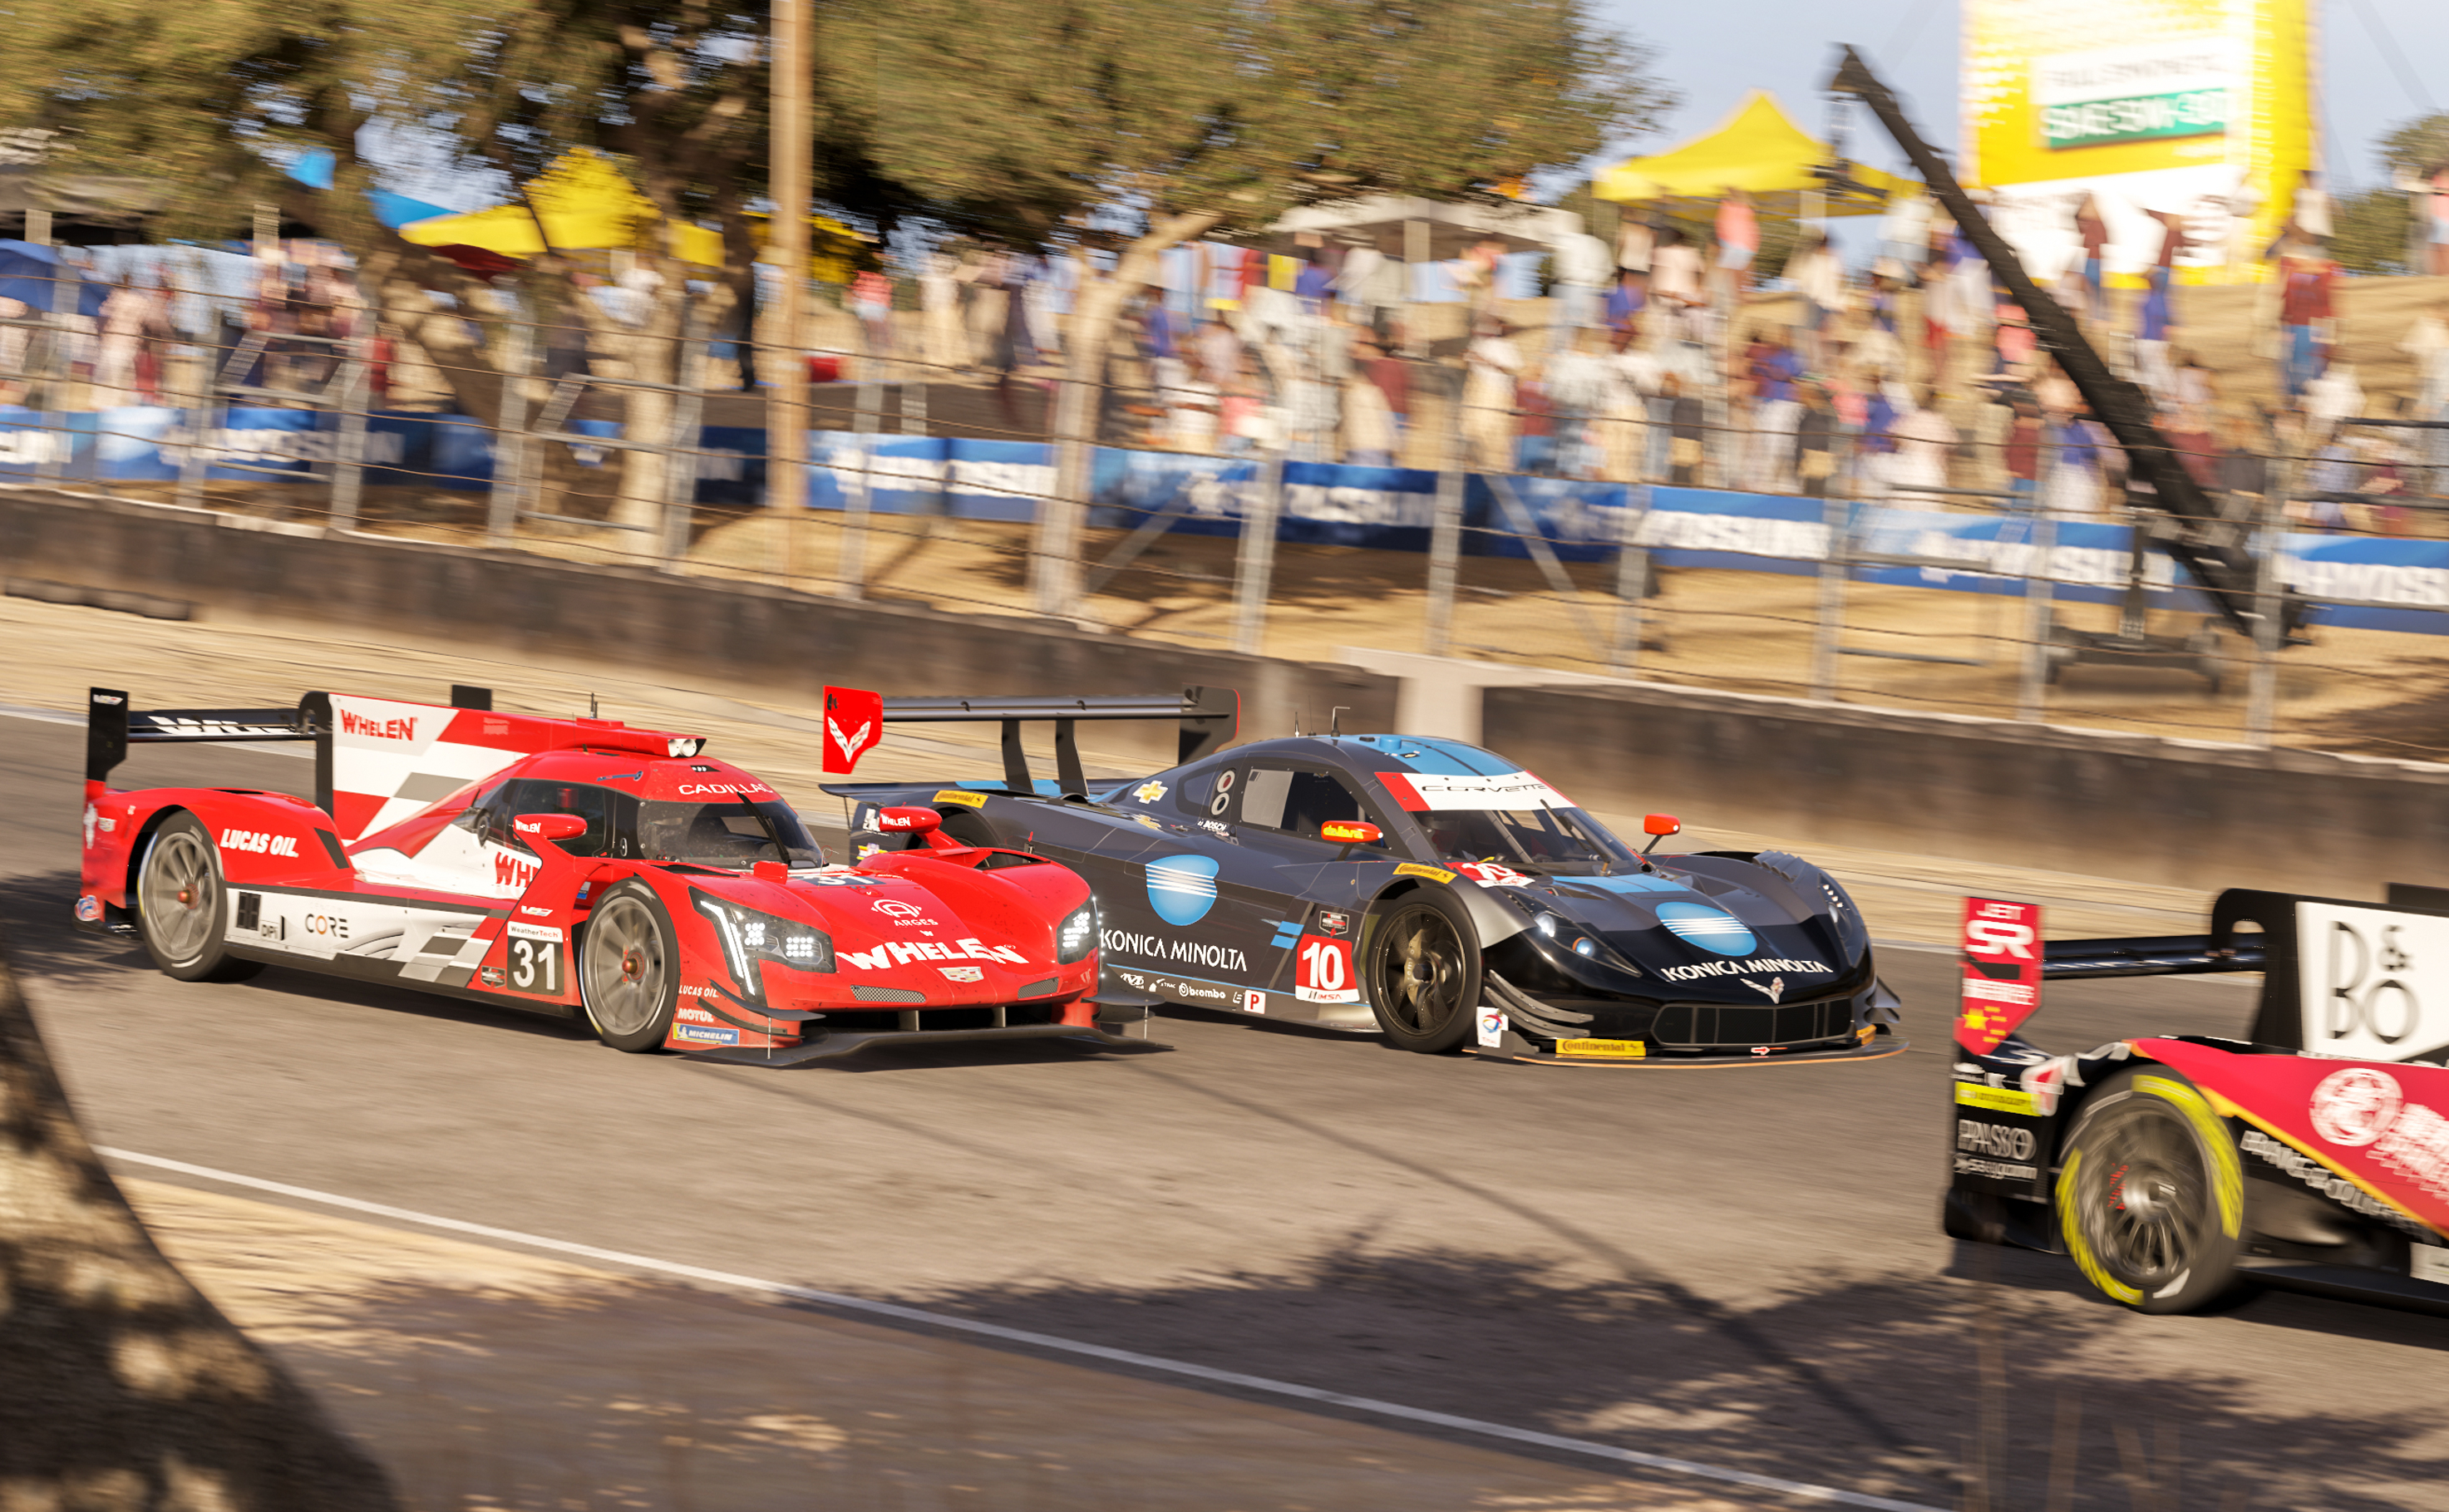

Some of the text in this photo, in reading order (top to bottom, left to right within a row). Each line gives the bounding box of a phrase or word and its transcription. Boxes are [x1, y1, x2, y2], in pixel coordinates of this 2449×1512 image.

[339, 707, 415, 742] WHELEN
[1422, 783, 1549, 793] CORVETTE
[515, 819, 542, 834] WHELEN
[880, 813, 912, 827] WHELEN
[219, 828, 271, 855] LUCAS
[305, 913, 349, 939] CORE
[894, 919, 939, 927] ARGES
[510, 925, 559, 938] WeatherTech
[835, 938, 1030, 970] WHELEN
[1100, 928, 1248, 973] KONICA MINOLTA
[513, 939, 556, 991] 31
[1302, 942, 1346, 991] 10
[1660, 958, 1834, 982] KONICA MINOLTA
[678, 984, 703, 997] LUCAS
[1189, 986, 1227, 1000] brembo
[1250, 994, 1260, 1009] P
[678, 1007, 715, 1023] MOTUL
[688, 1030, 733, 1042] MICHELIN
[1562, 1040, 1625, 1052] Continental
